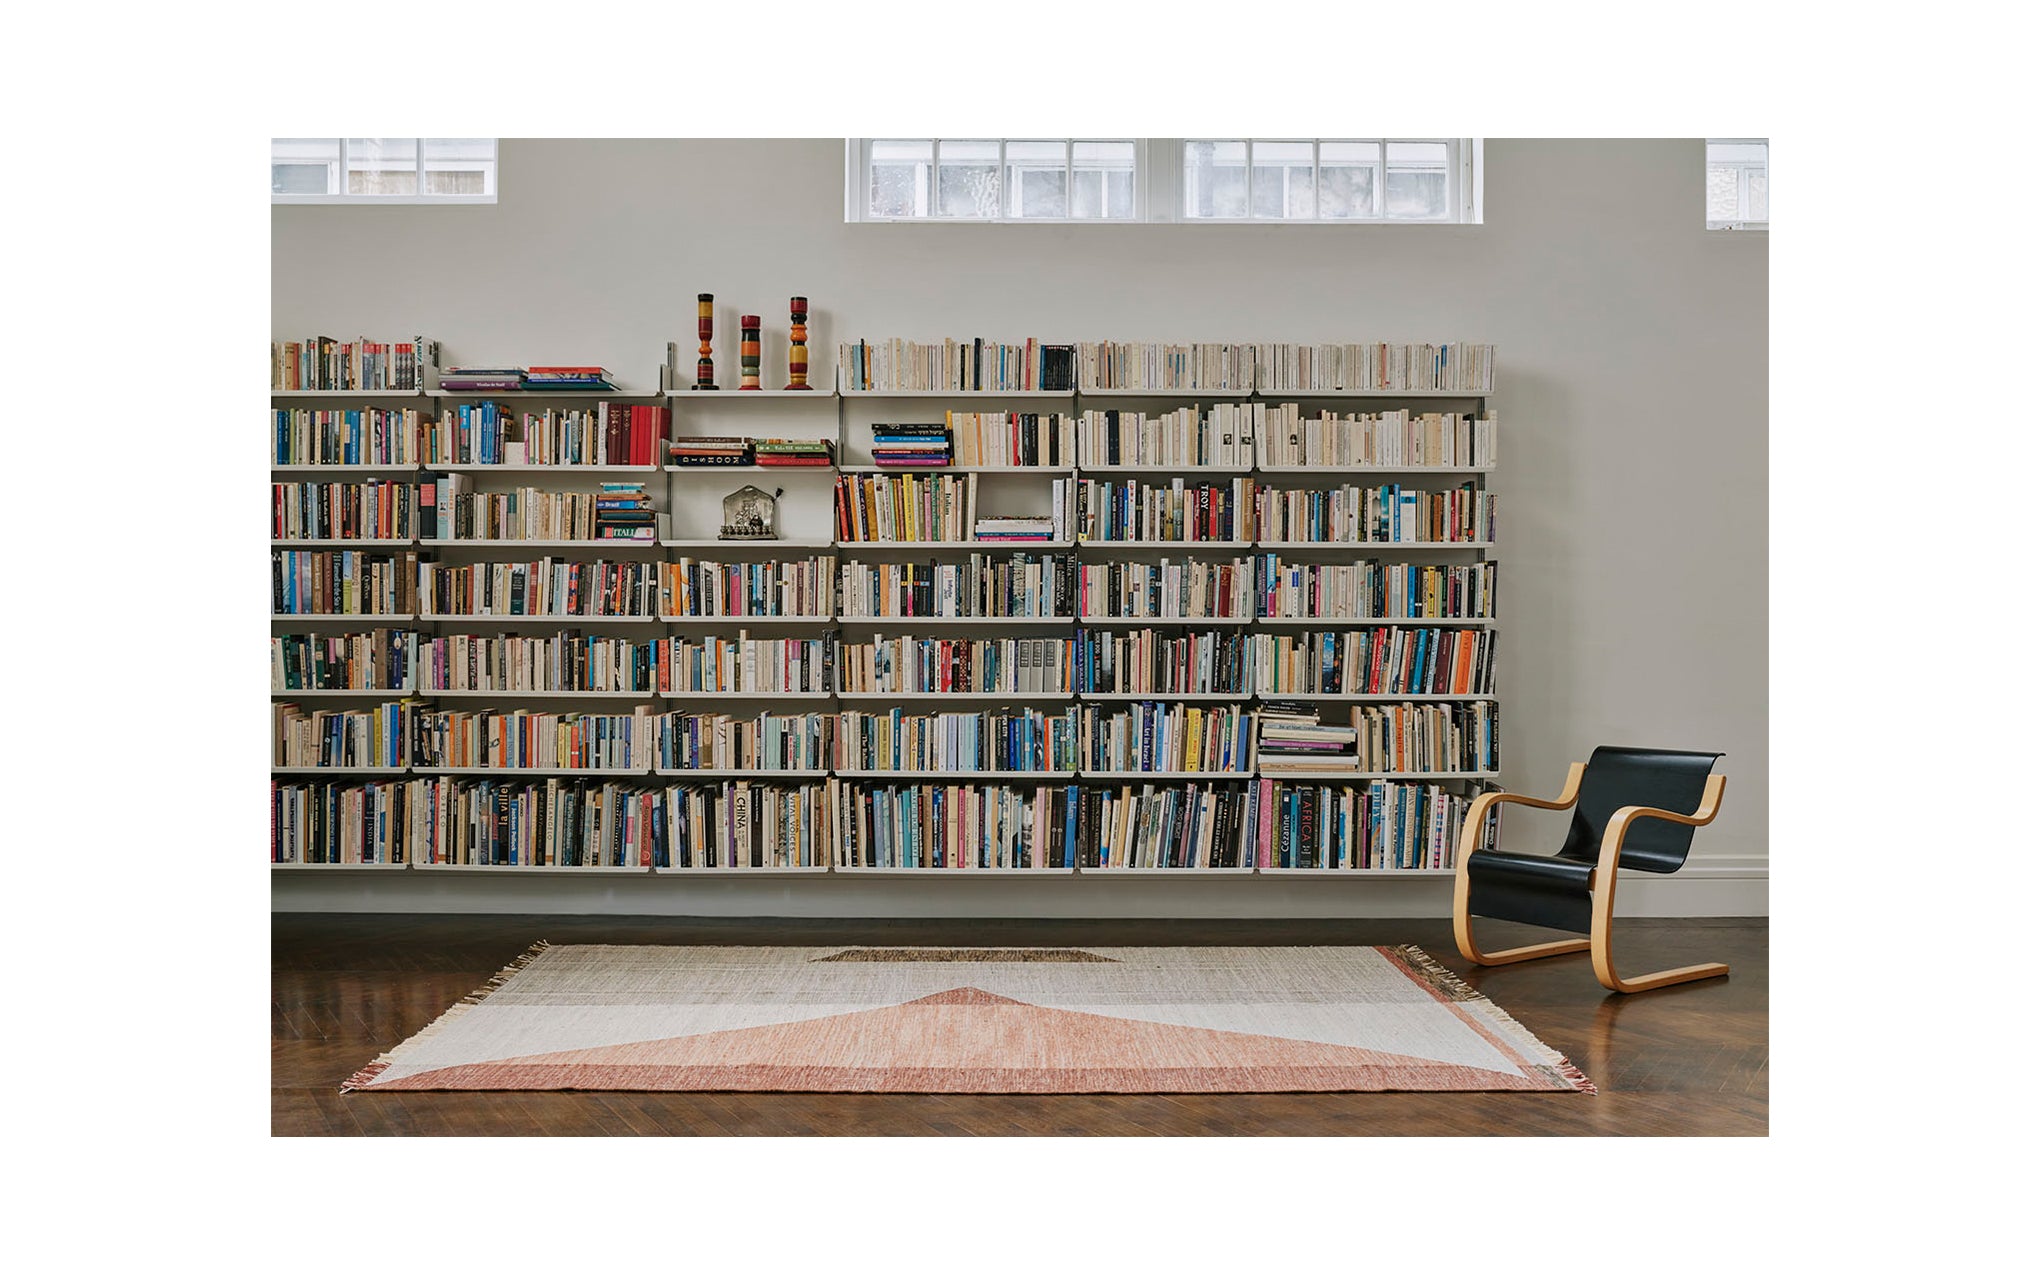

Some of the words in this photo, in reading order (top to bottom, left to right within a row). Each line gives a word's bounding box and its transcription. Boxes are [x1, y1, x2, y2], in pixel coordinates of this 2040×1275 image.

[683, 456, 740, 464] DISHOOM
[333, 562, 341, 582] Farewell
[333, 588, 341, 596] the
[333, 597, 341, 606] Sea
[498, 787, 509, 811] ville
[1372, 791, 1380, 817] DUFY
[498, 815, 509, 826] la
[737, 797, 748, 829] CHINA
[1302, 801, 1312, 842] AFRICA
[1281, 814, 1290, 852] Cézanne
